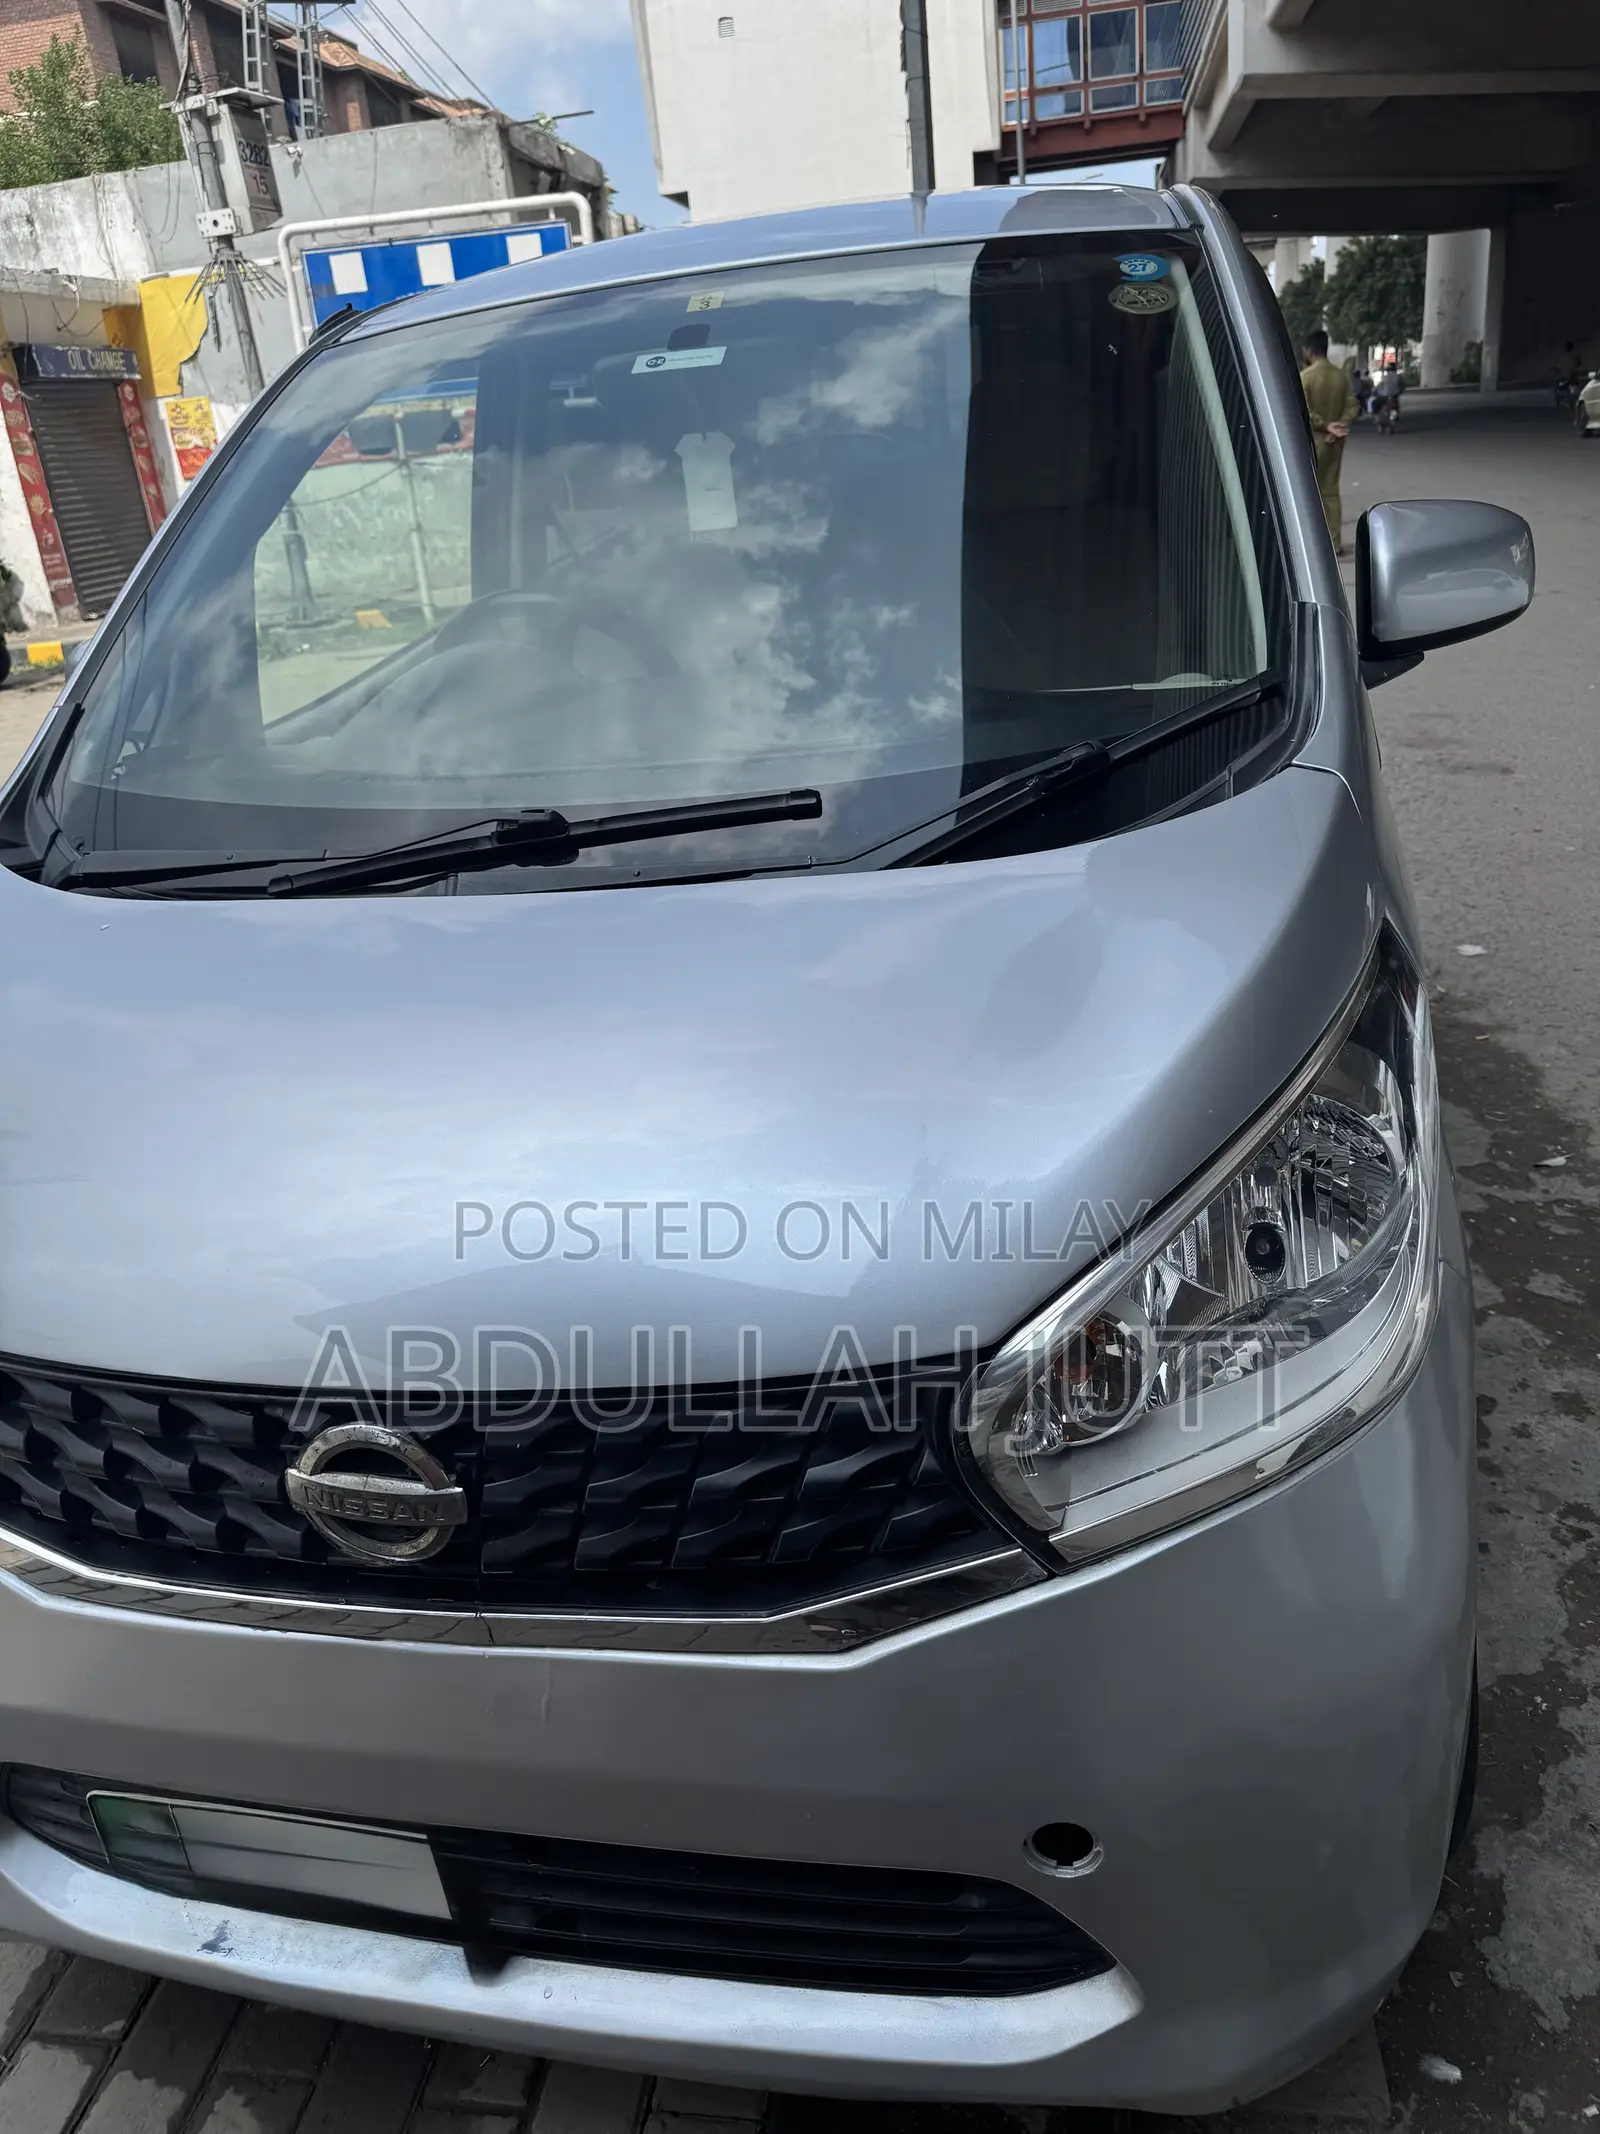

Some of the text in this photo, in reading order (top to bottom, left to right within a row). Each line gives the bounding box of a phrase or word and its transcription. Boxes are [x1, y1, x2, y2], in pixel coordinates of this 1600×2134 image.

[252, 175, 269, 195] 15
[1128, 263, 1147, 273] 27
[699, 301, 710, 310] 3
[68, 350, 127, 371] OIL CHANGE
[301, 1481, 445, 1522] NISSAN
